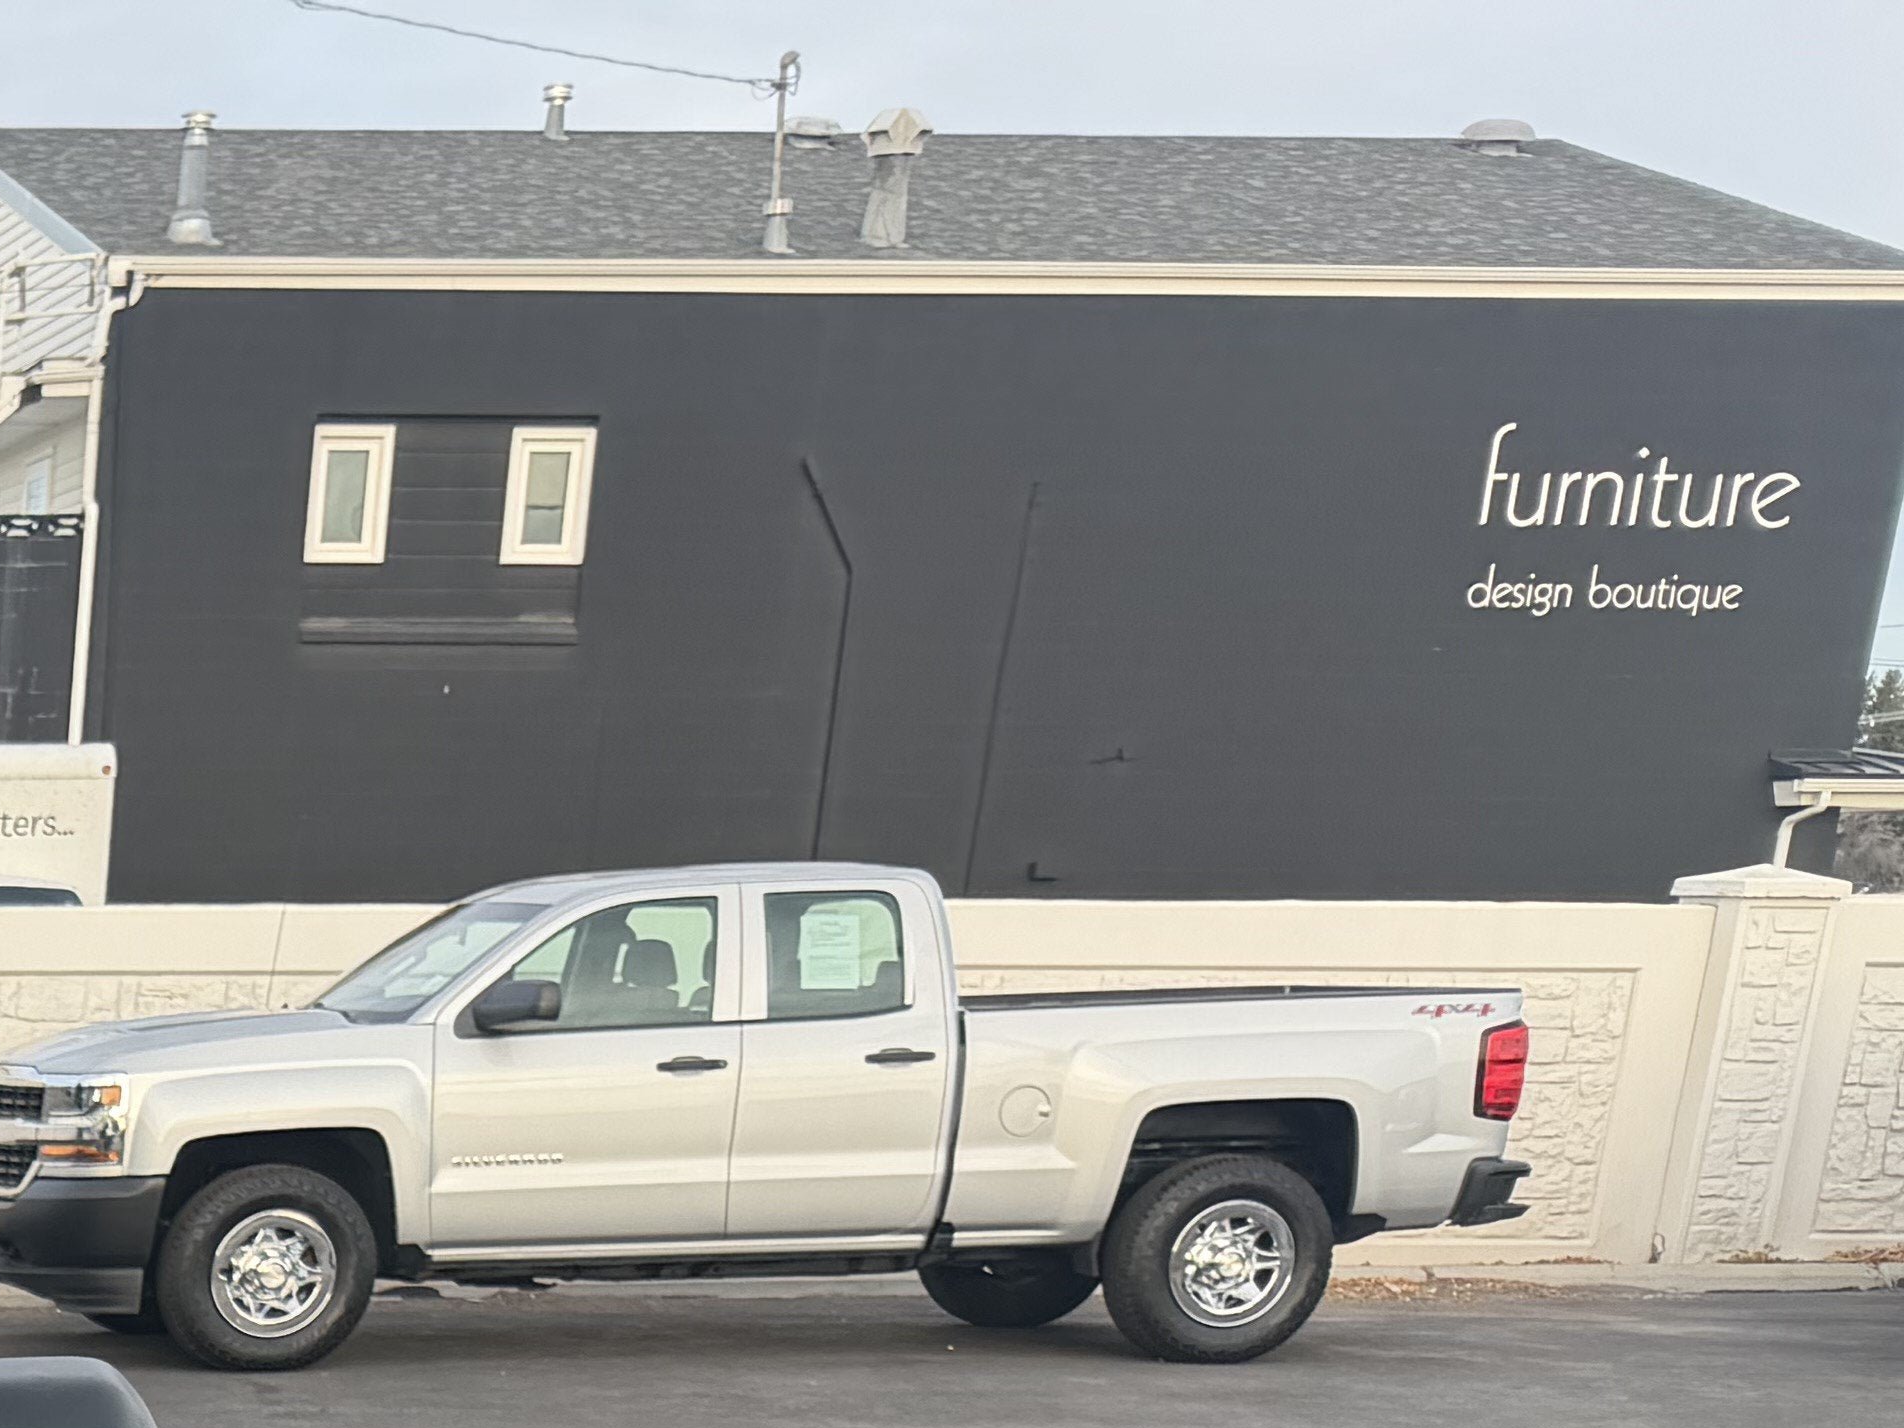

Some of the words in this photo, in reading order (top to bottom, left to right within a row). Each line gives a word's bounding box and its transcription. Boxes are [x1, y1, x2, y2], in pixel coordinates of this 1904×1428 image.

[1478, 422, 1801, 528] furniture
[1466, 563, 1573, 617] design
[1588, 564, 1744, 617] boutique
